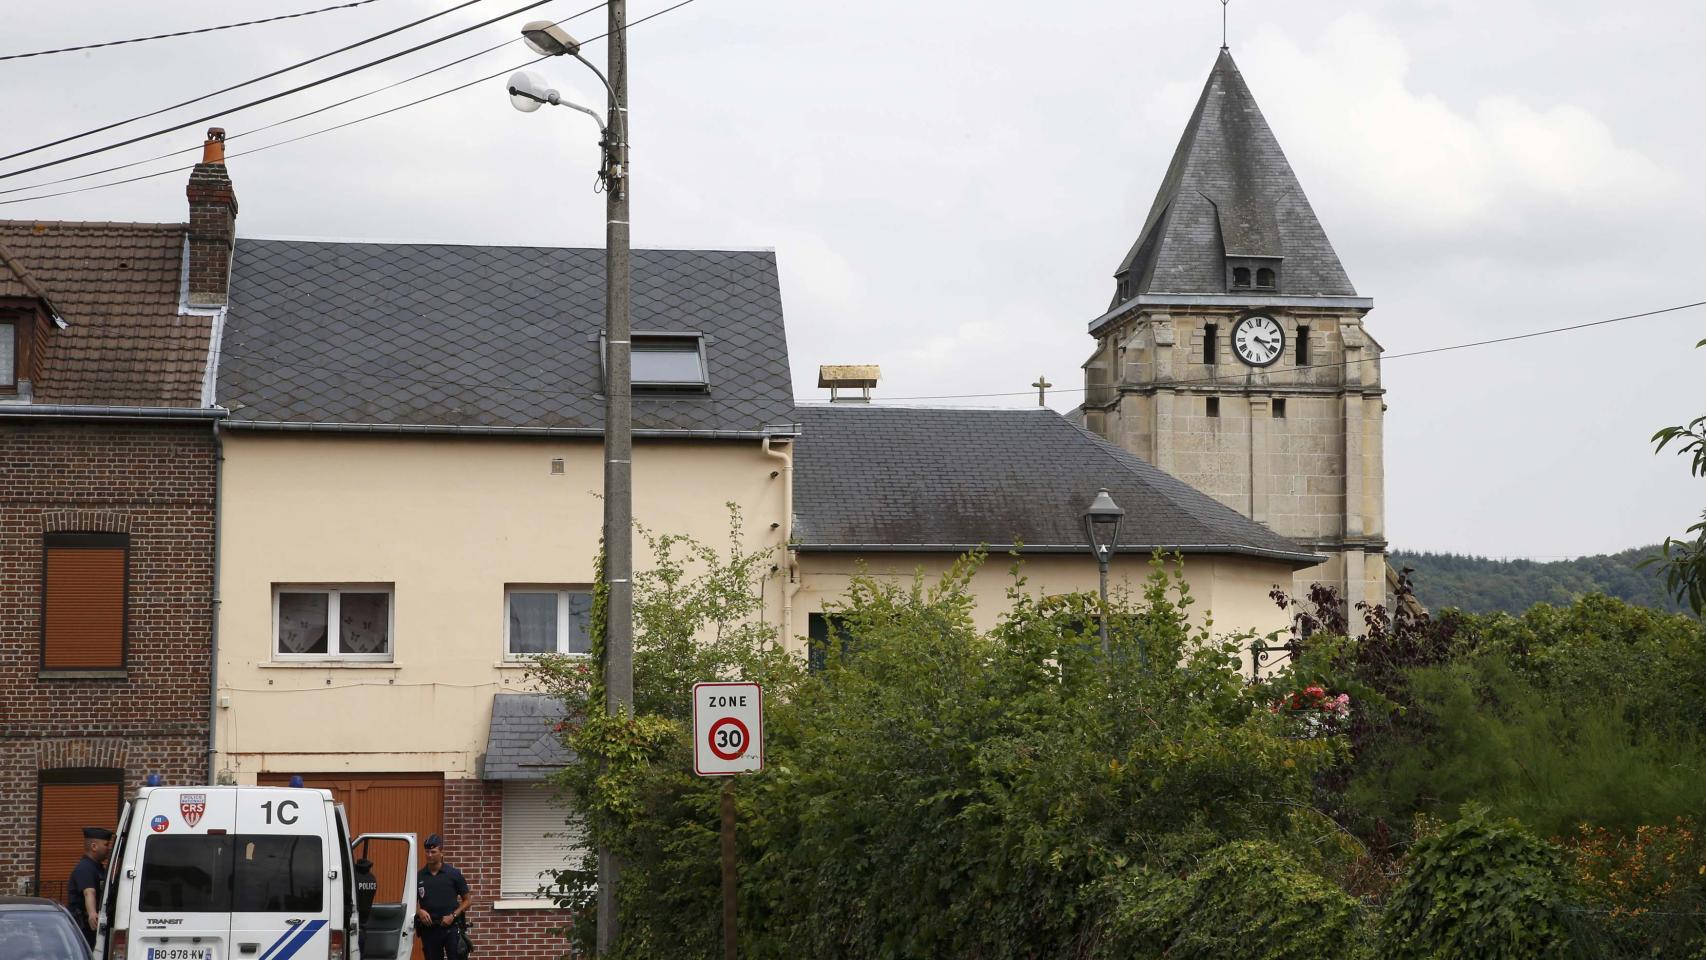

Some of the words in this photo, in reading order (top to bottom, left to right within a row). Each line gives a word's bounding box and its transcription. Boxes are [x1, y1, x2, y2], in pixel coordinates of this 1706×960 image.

[709, 696, 747, 707] ZONE
[717, 730, 741, 748] 30
[182, 804, 204, 812] CRS
[261, 800, 299, 825] 1C
[359, 882, 377, 890] POLICE
